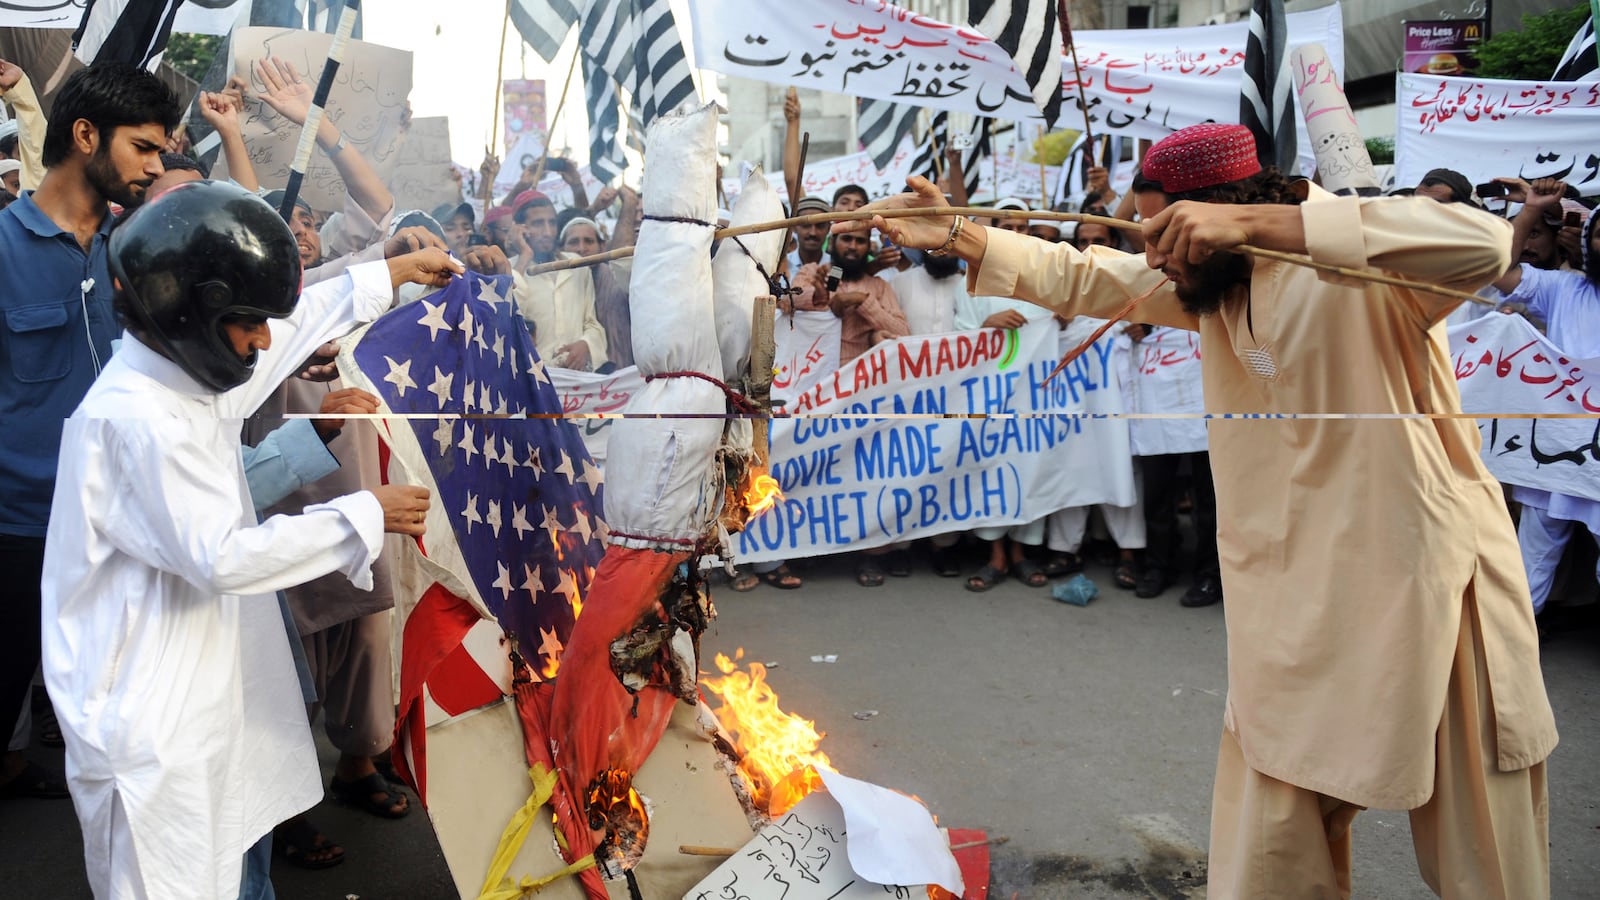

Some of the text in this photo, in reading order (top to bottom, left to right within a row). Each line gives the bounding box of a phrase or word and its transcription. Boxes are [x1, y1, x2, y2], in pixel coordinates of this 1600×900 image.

[1409, 25, 1454, 38] Price Less
[724, 34, 838, 77] نبوت
[842, 48, 907, 92] ختم
[794, 350, 888, 413] ALLAH
[960, 371, 1021, 414] THE
[854, 423, 943, 482] MADE
[877, 461, 1021, 539] (P.B.U.H)
